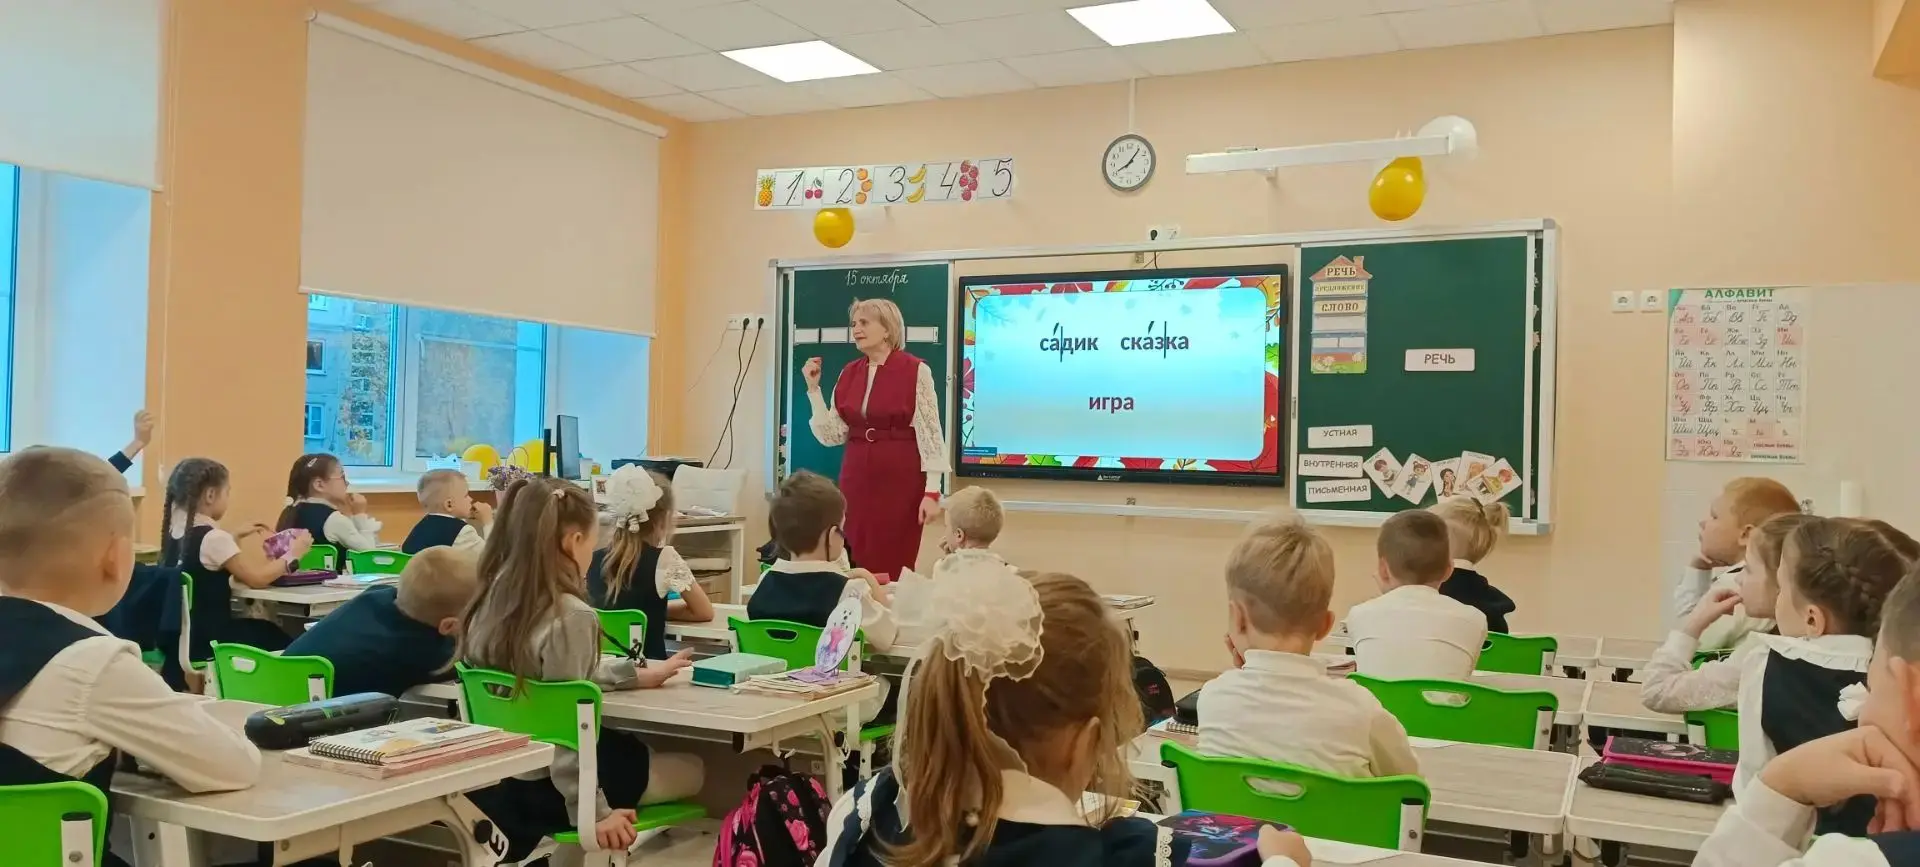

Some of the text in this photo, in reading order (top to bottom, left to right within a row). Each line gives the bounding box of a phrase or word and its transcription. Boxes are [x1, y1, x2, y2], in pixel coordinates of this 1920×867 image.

[786, 157, 1013, 206] 1 2 3 4 5
[1327, 267, 1356, 277] РЕЧЬ
[845, 268, 909, 292] 15 октября
[1704, 289, 1776, 298] АЛФАВИТ
[1321, 302, 1359, 312] СЛОВО
[1424, 353, 1456, 365] РЕЧЬ
[1088, 394, 1135, 414] игра
[1323, 429, 1358, 438] УСТНАЯ
[1303, 458, 1359, 469] ВНУТРЕННЯЯ
[1308, 484, 1368, 495] ПИСЬМЕННАЯ
